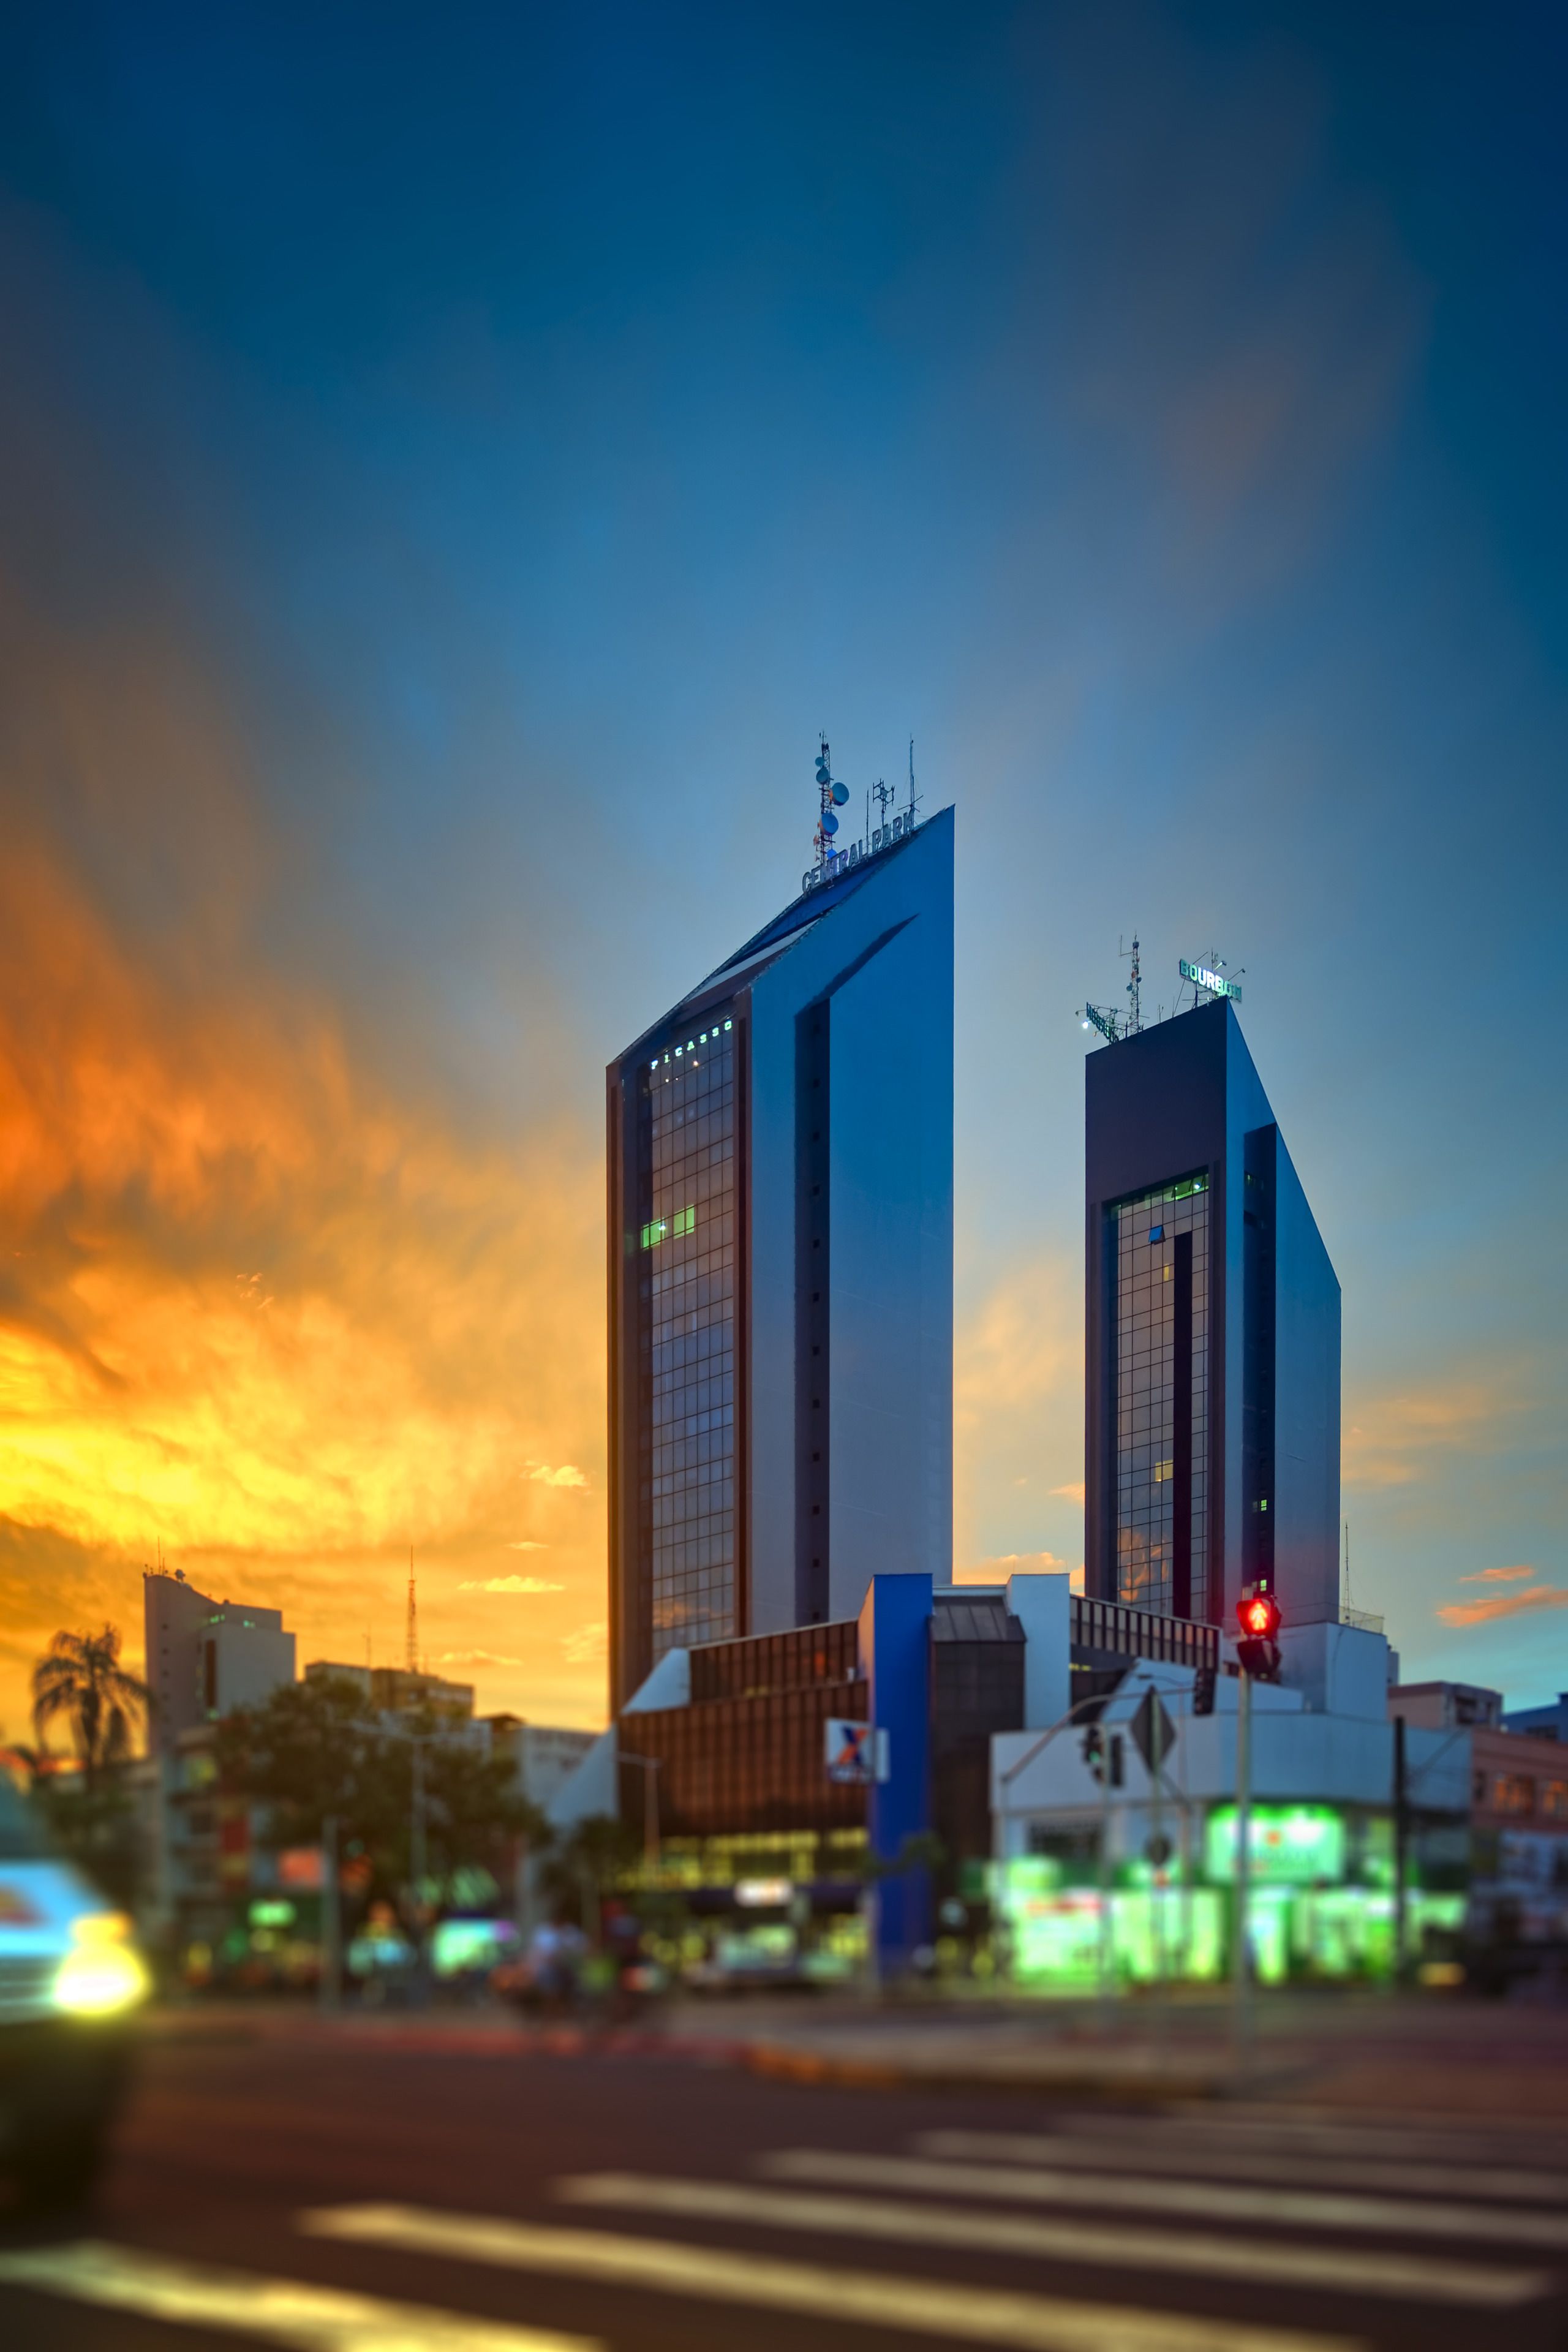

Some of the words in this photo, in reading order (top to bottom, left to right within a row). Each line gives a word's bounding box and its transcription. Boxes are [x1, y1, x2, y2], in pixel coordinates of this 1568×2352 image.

[802, 840, 869, 893] CENTRAL
[872, 810, 914, 854] PARK
[1180, 959, 1242, 1003] BOURBON
[650, 1020, 733, 1070] PICASSO
